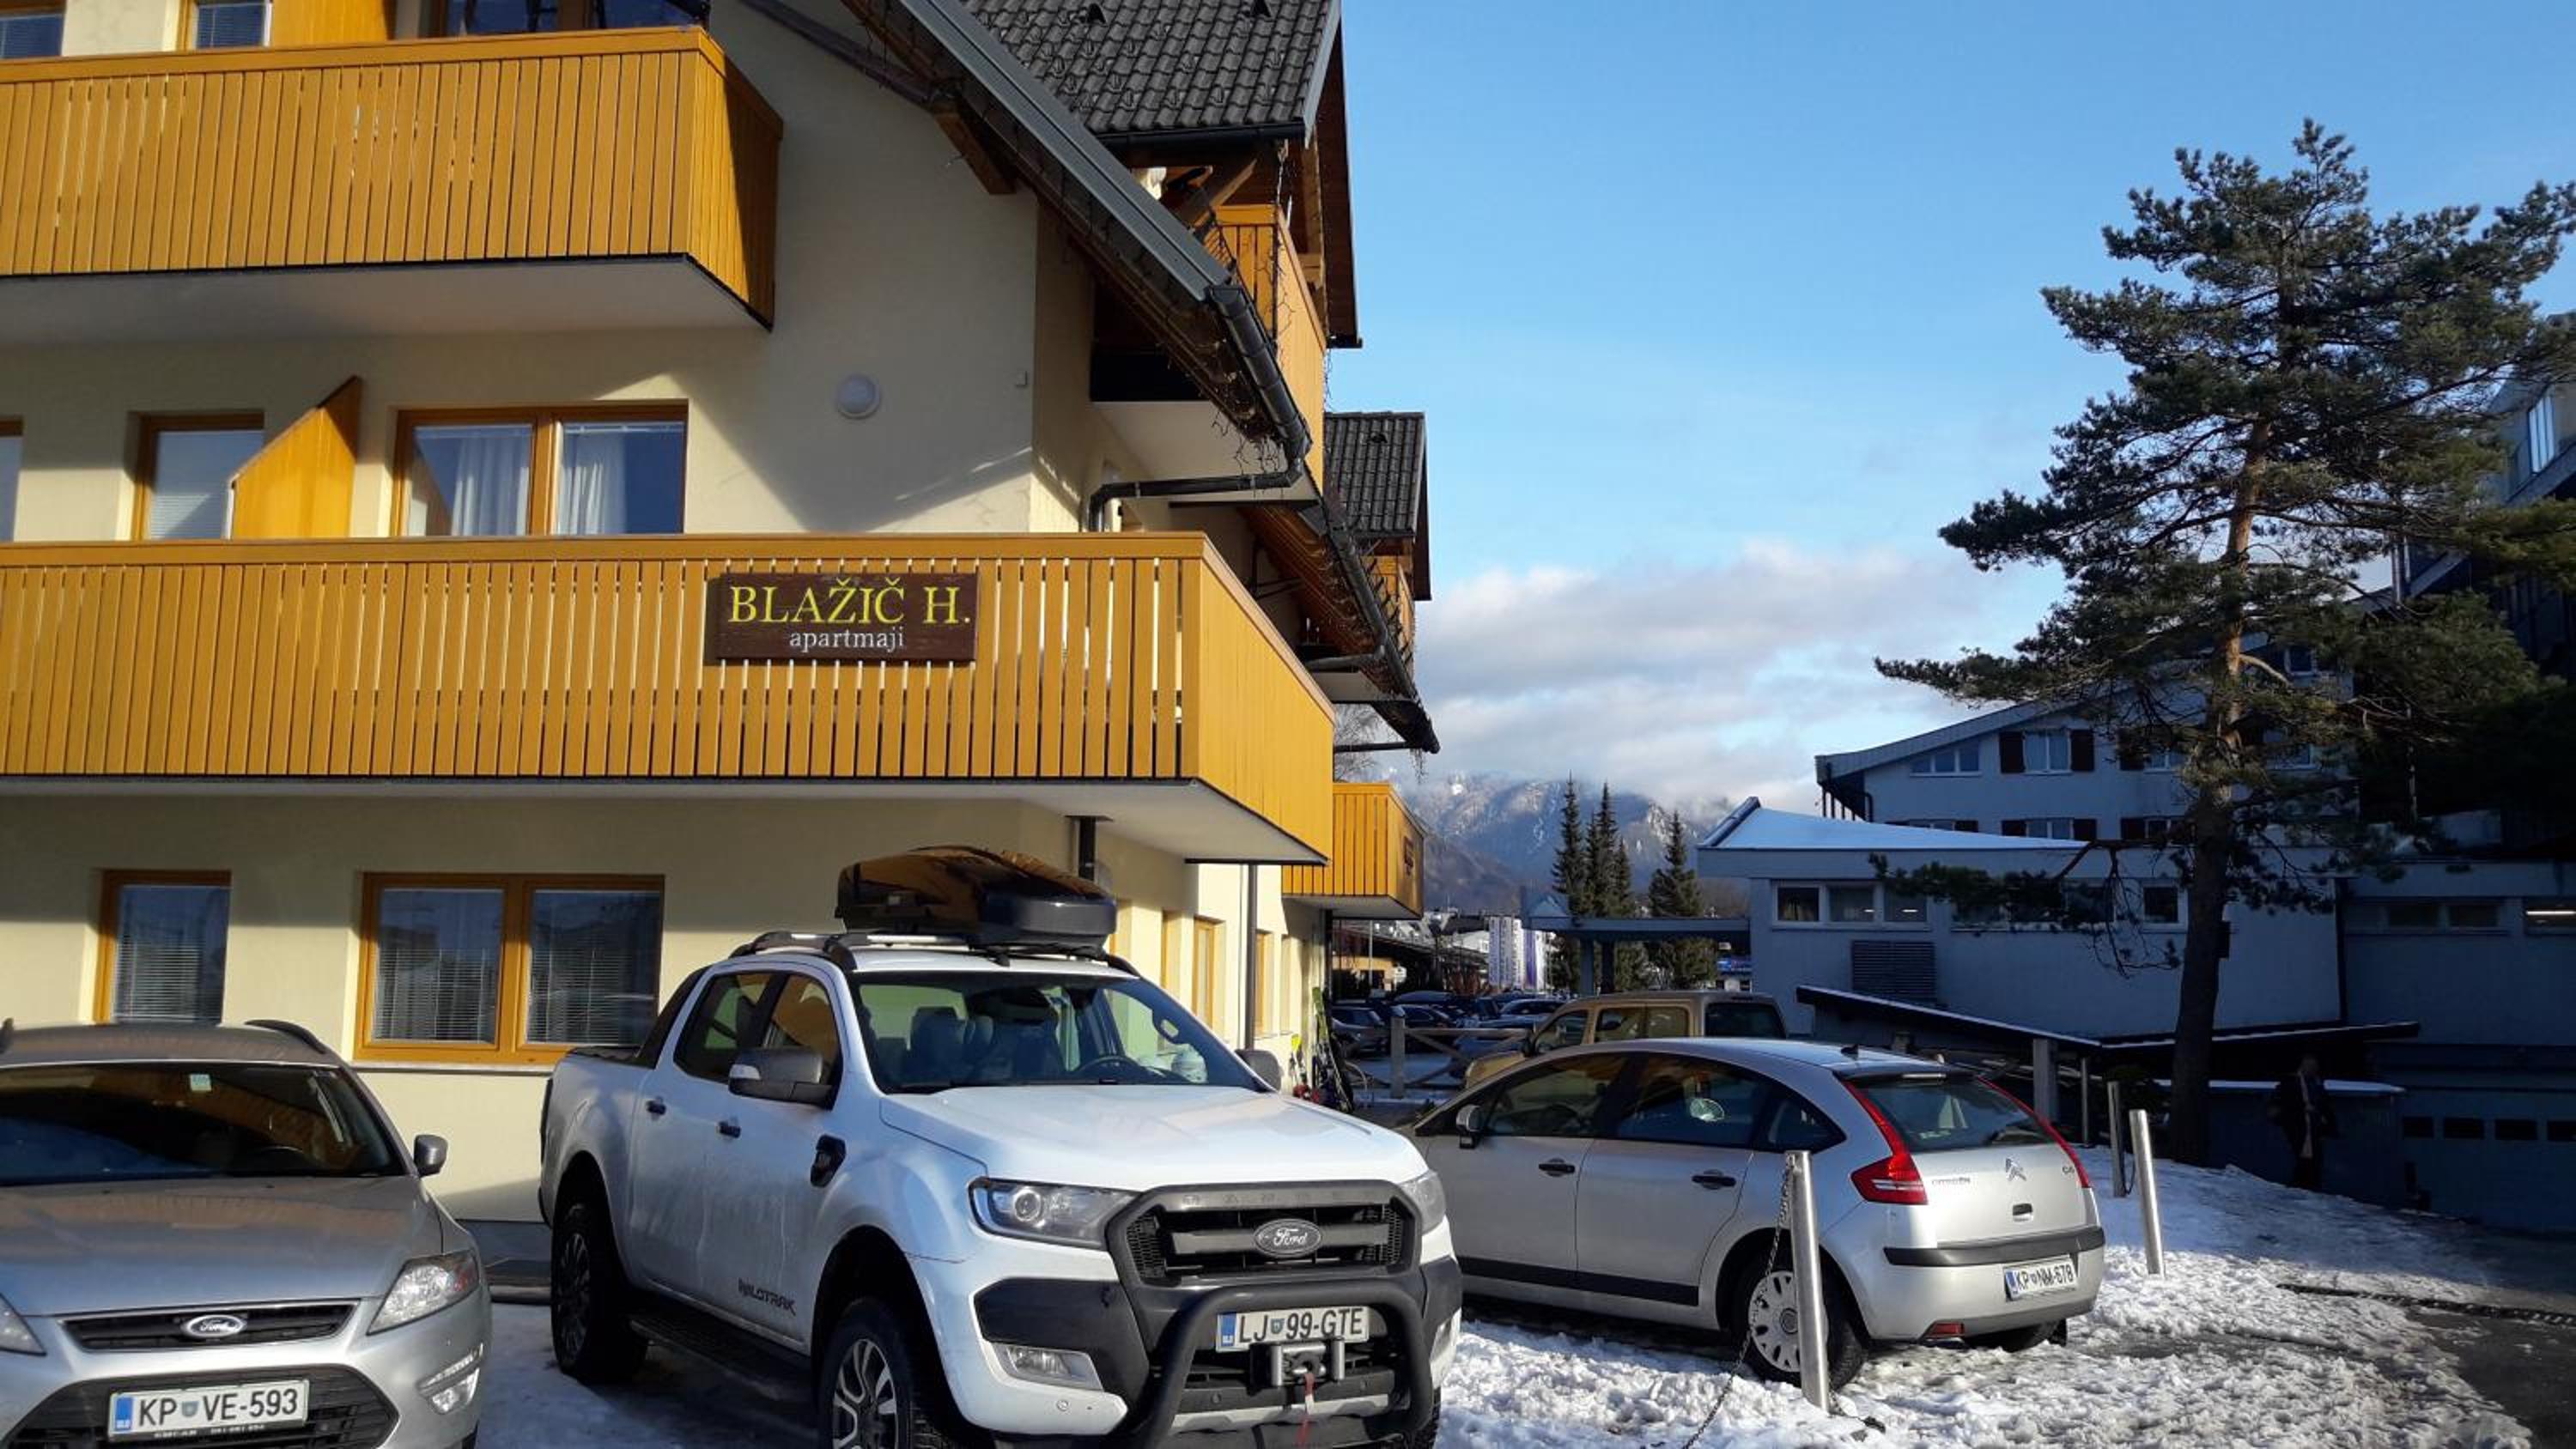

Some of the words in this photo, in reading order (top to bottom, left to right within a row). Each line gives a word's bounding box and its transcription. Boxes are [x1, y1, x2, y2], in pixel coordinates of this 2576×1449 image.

[728, 577, 905, 624] BLAŽIČ
[923, 586, 970, 624] H.
[790, 627, 904, 652] apartmaji
[1273, 1228, 1308, 1246] Ford
[1239, 1314, 1268, 1343] LJ
[1285, 1307, 1364, 1340] 99-GTE
[139, 1397, 177, 1427] KP
[203, 1388, 298, 1422] VE-593
